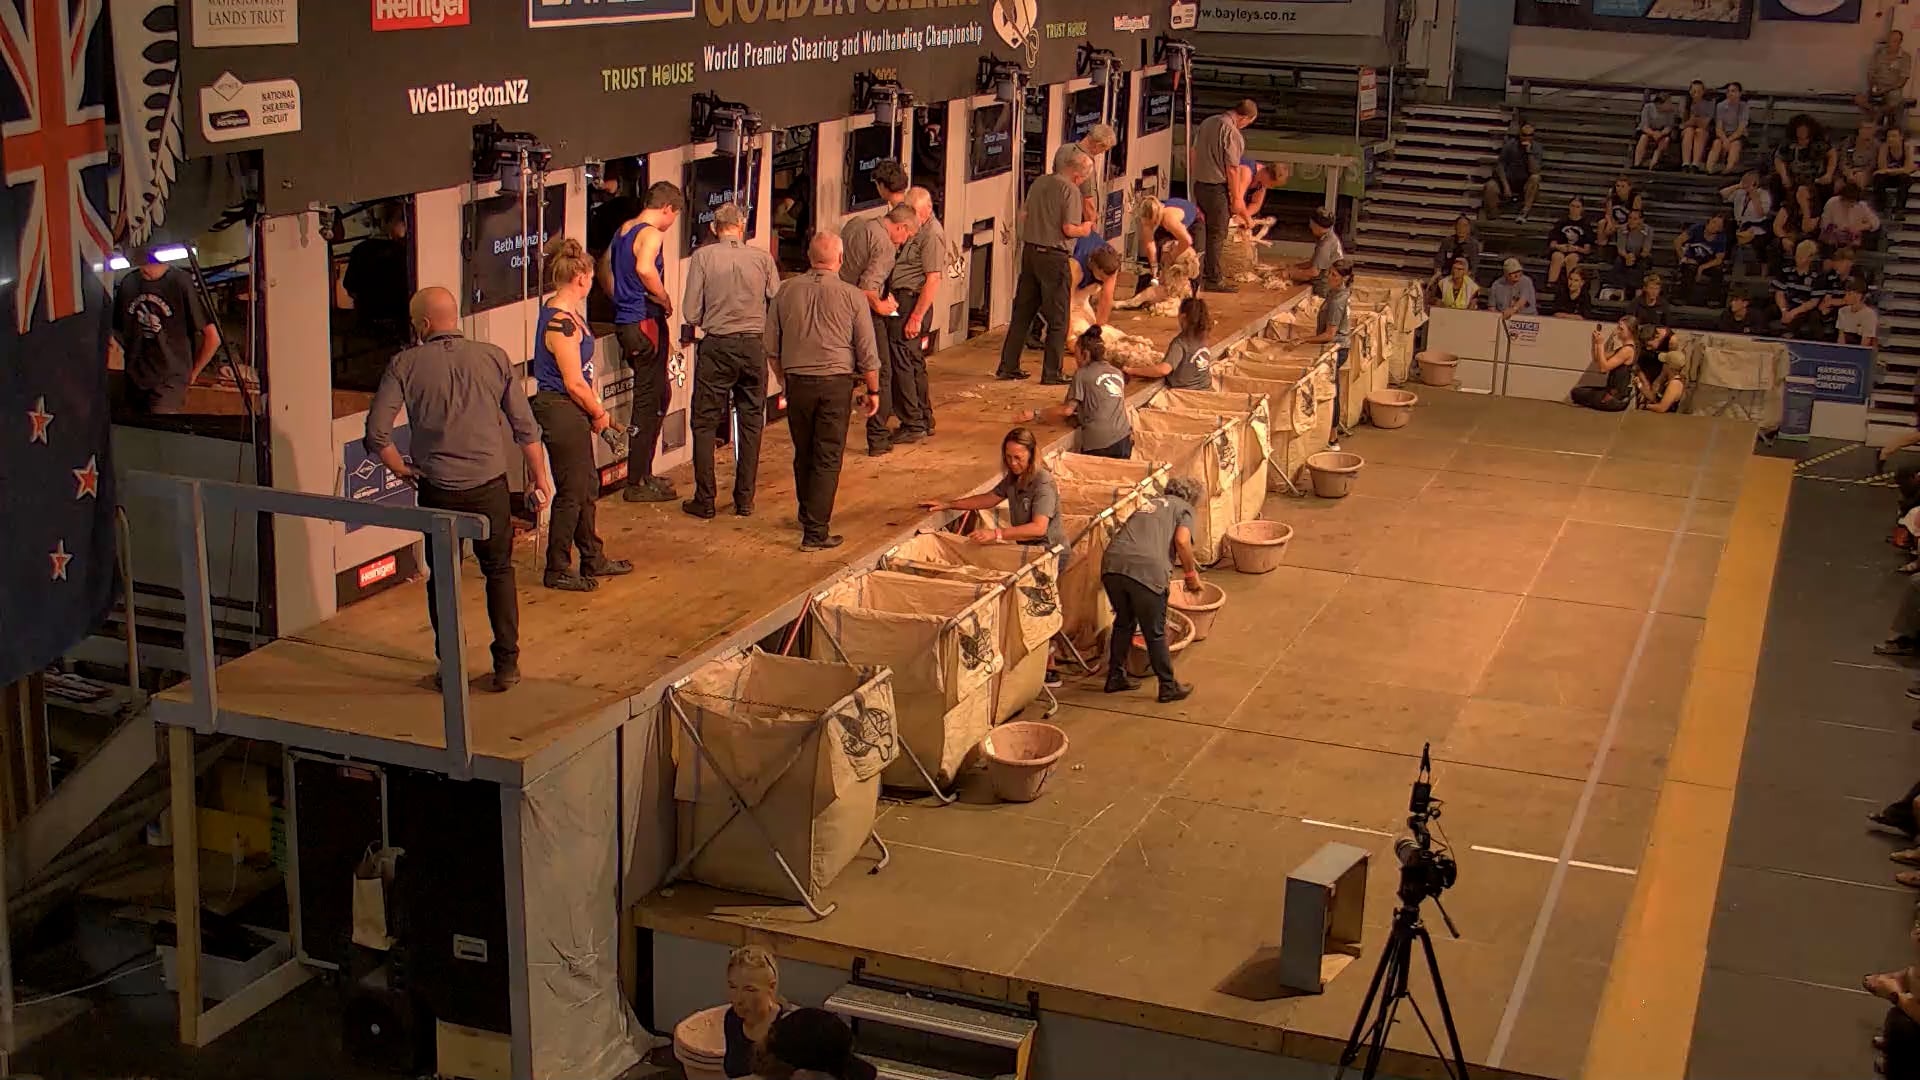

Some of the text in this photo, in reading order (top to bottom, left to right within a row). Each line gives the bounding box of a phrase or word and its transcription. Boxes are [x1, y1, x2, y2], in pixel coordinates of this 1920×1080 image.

[208, 9, 285, 25] LANDS TRUST
[703, 20, 982, 72] World Premier Shearing and Woolhandling Championship
[601, 62, 695, 92] TRUST HOUSE
[262, 89, 295, 101] NATIONAL
[408, 79, 529, 115] WellingtonNZ
[262, 113, 289, 125] CIRCUIT
[494, 238, 514, 254] Beth
